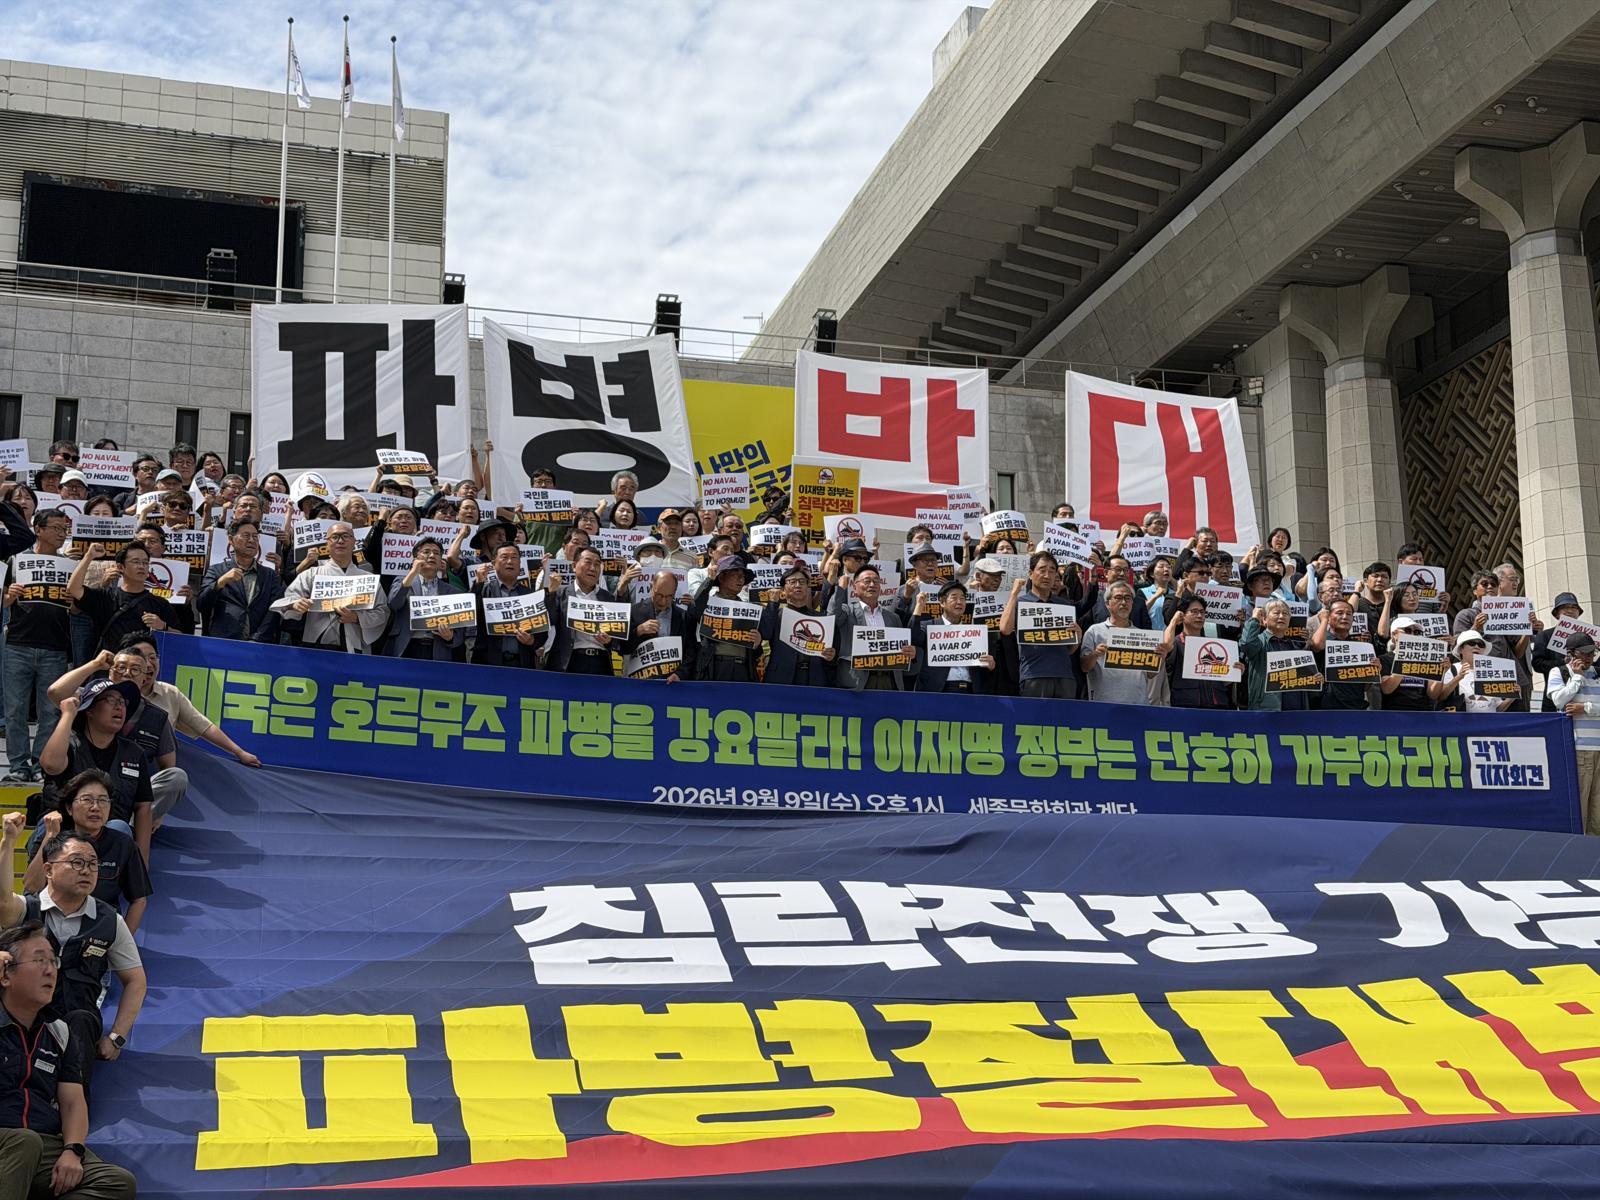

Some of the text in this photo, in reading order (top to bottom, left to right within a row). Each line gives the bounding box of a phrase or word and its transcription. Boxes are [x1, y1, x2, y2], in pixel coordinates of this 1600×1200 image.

[278, 319, 1237, 543] 파 병 반 대
[94, 454, 121, 462] NAVAL
[82, 463, 134, 472] DEPLOYMENT
[93, 473, 130, 481] HORMUZ!
[703, 477, 737, 486] NO NAVAL
[524, 491, 549, 500] 국민을
[704, 486, 748, 497] DEPLOYMENT
[798, 485, 854, 498] 이재명 정부는
[534, 500, 572, 510] 전쟁터에
[798, 496, 854, 514] 침략전쟁
[296, 522, 320, 534] 미국은
[434, 526, 452, 534] NOT
[186, 533, 205, 542] 지원
[1046, 526, 1087, 546] DO NOT JOIN
[1054, 538, 1071, 548] WAR
[186, 544, 206, 554] 파견
[18, 560, 56, 570] 호르무즈
[384, 562, 396, 570] TO
[314, 576, 376, 590] 침략전쟁 지원
[975, 596, 996, 605] 미국은
[1224, 591, 1240, 600] JOIN
[412, 598, 440, 608] 미국은
[486, 598, 522, 610] 호르무즈
[570, 601, 604, 611] 호르무즈
[1484, 601, 1526, 610] DO NOT JOIN
[412, 602, 473, 616] 호르무즈 파병
[501, 602, 547, 620] 파병검토
[732, 606, 760, 619] 멈춰라!
[975, 605, 1004, 616] 호르무즈
[1020, 607, 1052, 616] 호르무즈
[425, 612, 475, 628] 강요말라!
[584, 611, 628, 620] 파병검토
[1431, 616, 1444, 626] 지원
[1490, 612, 1519, 620] WAR OF
[494, 616, 548, 634] 즉각 중단!
[572, 620, 626, 633] 즉각 중단!
[703, 616, 733, 630] 파병을
[1032, 616, 1074, 628] 파병검토
[1486, 622, 1531, 632] AGGRESSION!
[1558, 620, 1572, 628] NO
[856, 630, 886, 641] 국민을
[1024, 629, 1074, 642] 즉각 중단!
[1433, 626, 1448, 634] 파견
[868, 640, 908, 652] 전쟁터에
[961, 641, 972, 649] OF
[1327, 644, 1350, 654] 미국은
[1400, 640, 1444, 651] 침략전쟁 지원
[1552, 640, 1563, 648] TO
[640, 648, 680, 665] 전쟁터에
[932, 652, 986, 662] AGGRESSIO
[1106, 650, 1160, 668] 파병반대
[1328, 655, 1359, 665] 호르무즈
[1398, 650, 1428, 660] 군사자산
[854, 656, 884, 668] 보내지
[1270, 658, 1292, 670] 전쟁을
[1474, 660, 1492, 668] 미국은
[1195, 664, 1230, 675] 파병반대
[1338, 667, 1379, 680] 강요말라!
[1401, 662, 1444, 676] 철회하라!
[1476, 670, 1516, 679] 호르무즈 파병
[1270, 668, 1298, 682] 파병을
[175, 664, 1464, 789] 미국은 호르무즈 파병을 강요말라! 이재명 정부는 단호히 거부하라!
[1472, 740, 1510, 762] 각계
[1474, 764, 1545, 787] 기자회견
[866, 794, 909, 812] 오후
[912, 796, 944, 814] 1시
[509, 880, 1318, 985] 침략전쟁
